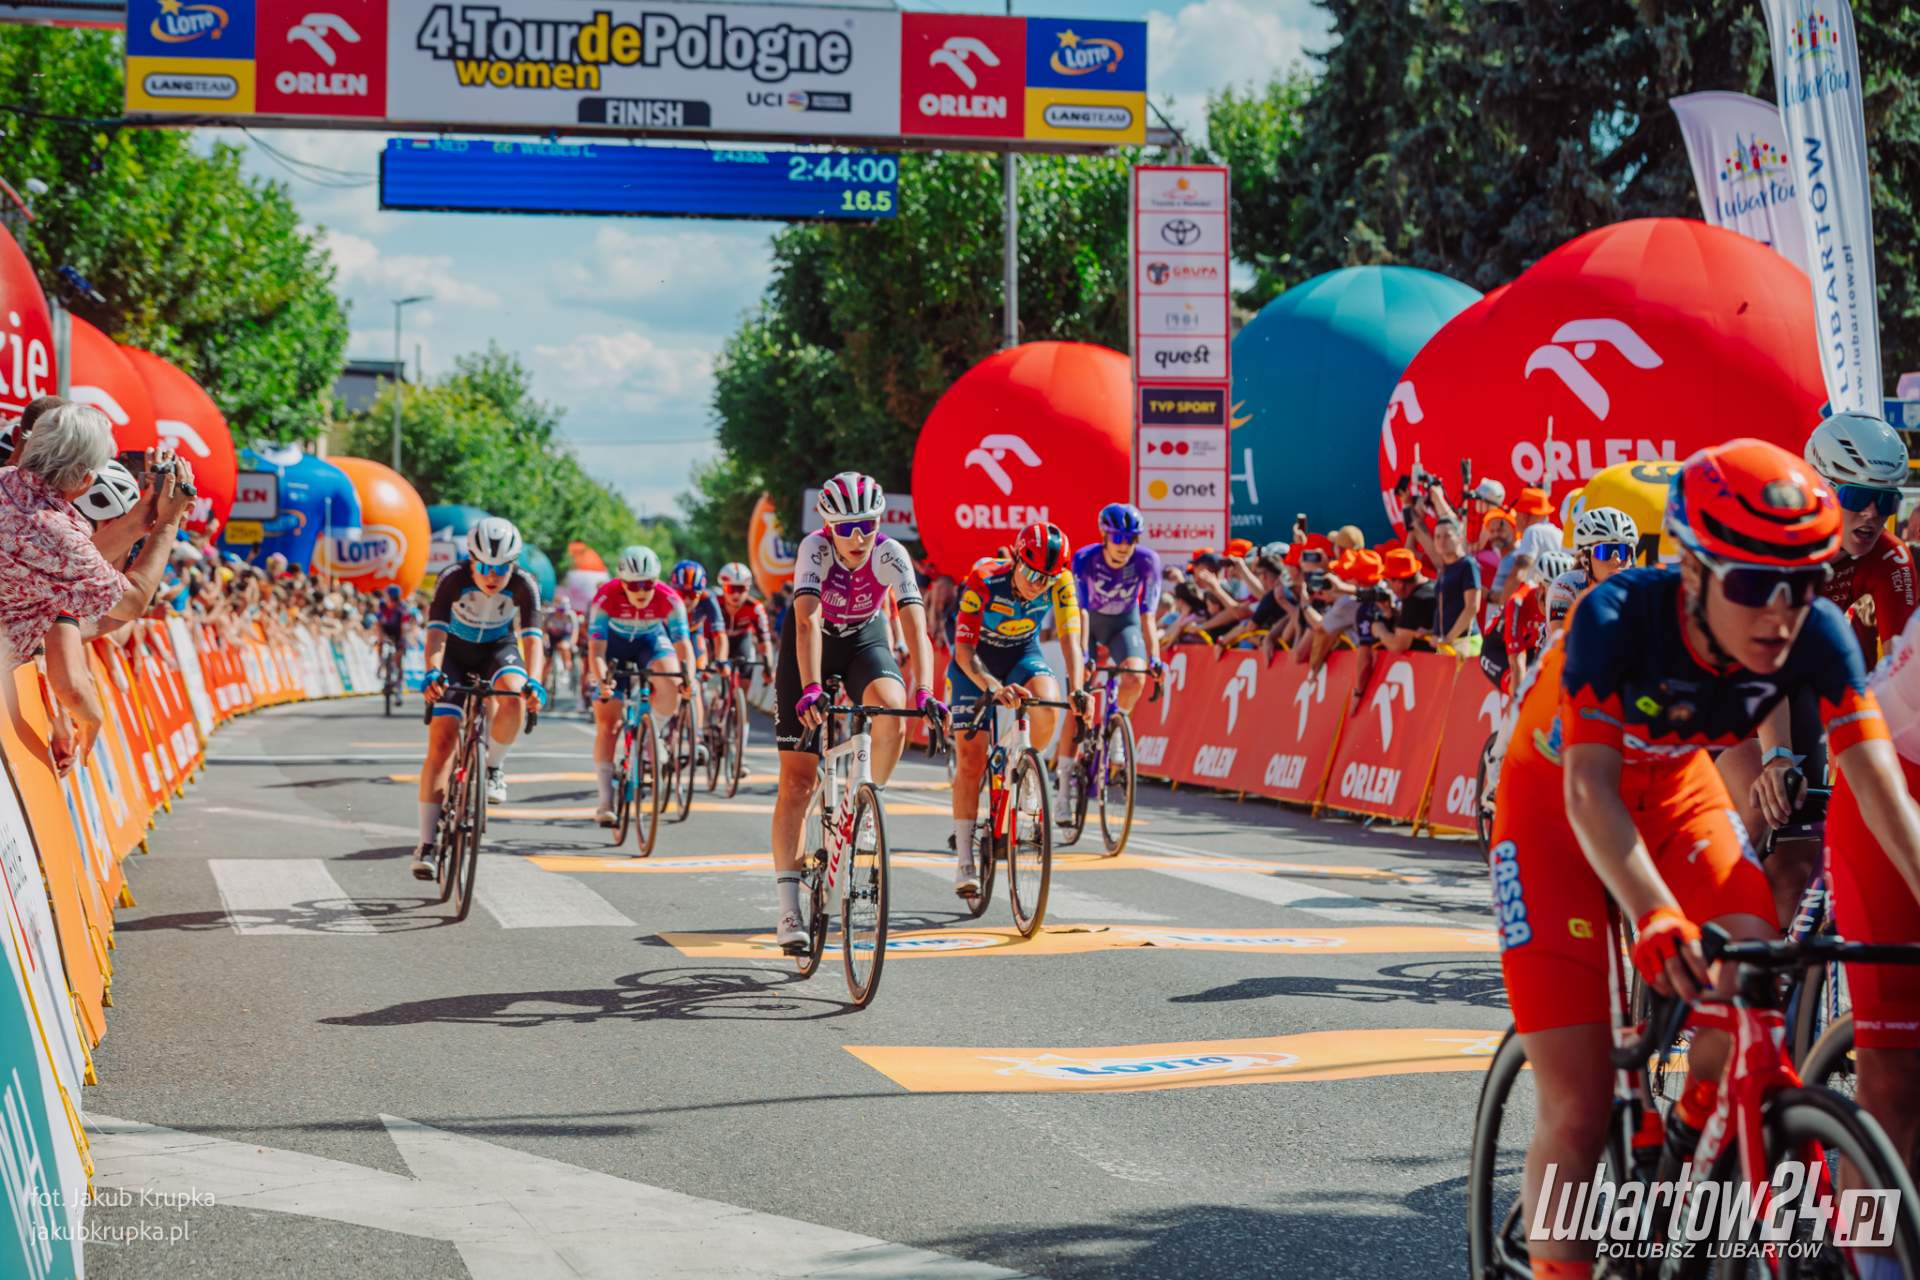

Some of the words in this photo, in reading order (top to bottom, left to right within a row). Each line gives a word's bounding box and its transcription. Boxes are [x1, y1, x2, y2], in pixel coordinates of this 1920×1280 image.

[275, 71, 368, 96] ORLEN
[455, 60, 601, 91] women
[747, 92, 782, 107] UCI
[918, 93, 1007, 118] ORLEN
[605, 100, 684, 127] FINISH
[788, 156, 897, 183] 2:44:00
[1150, 400, 1175, 413] TVP
[1177, 401, 1218, 413] SPORT
[1173, 482, 1216, 497] onet
[955, 505, 1049, 529] ORLEN
[1193, 744, 1238, 778] ORLEN
[1264, 753, 1307, 789] ORLEN
[1340, 761, 1402, 805] ORLEN
[1057, 1056, 1233, 1075] LOTTO
